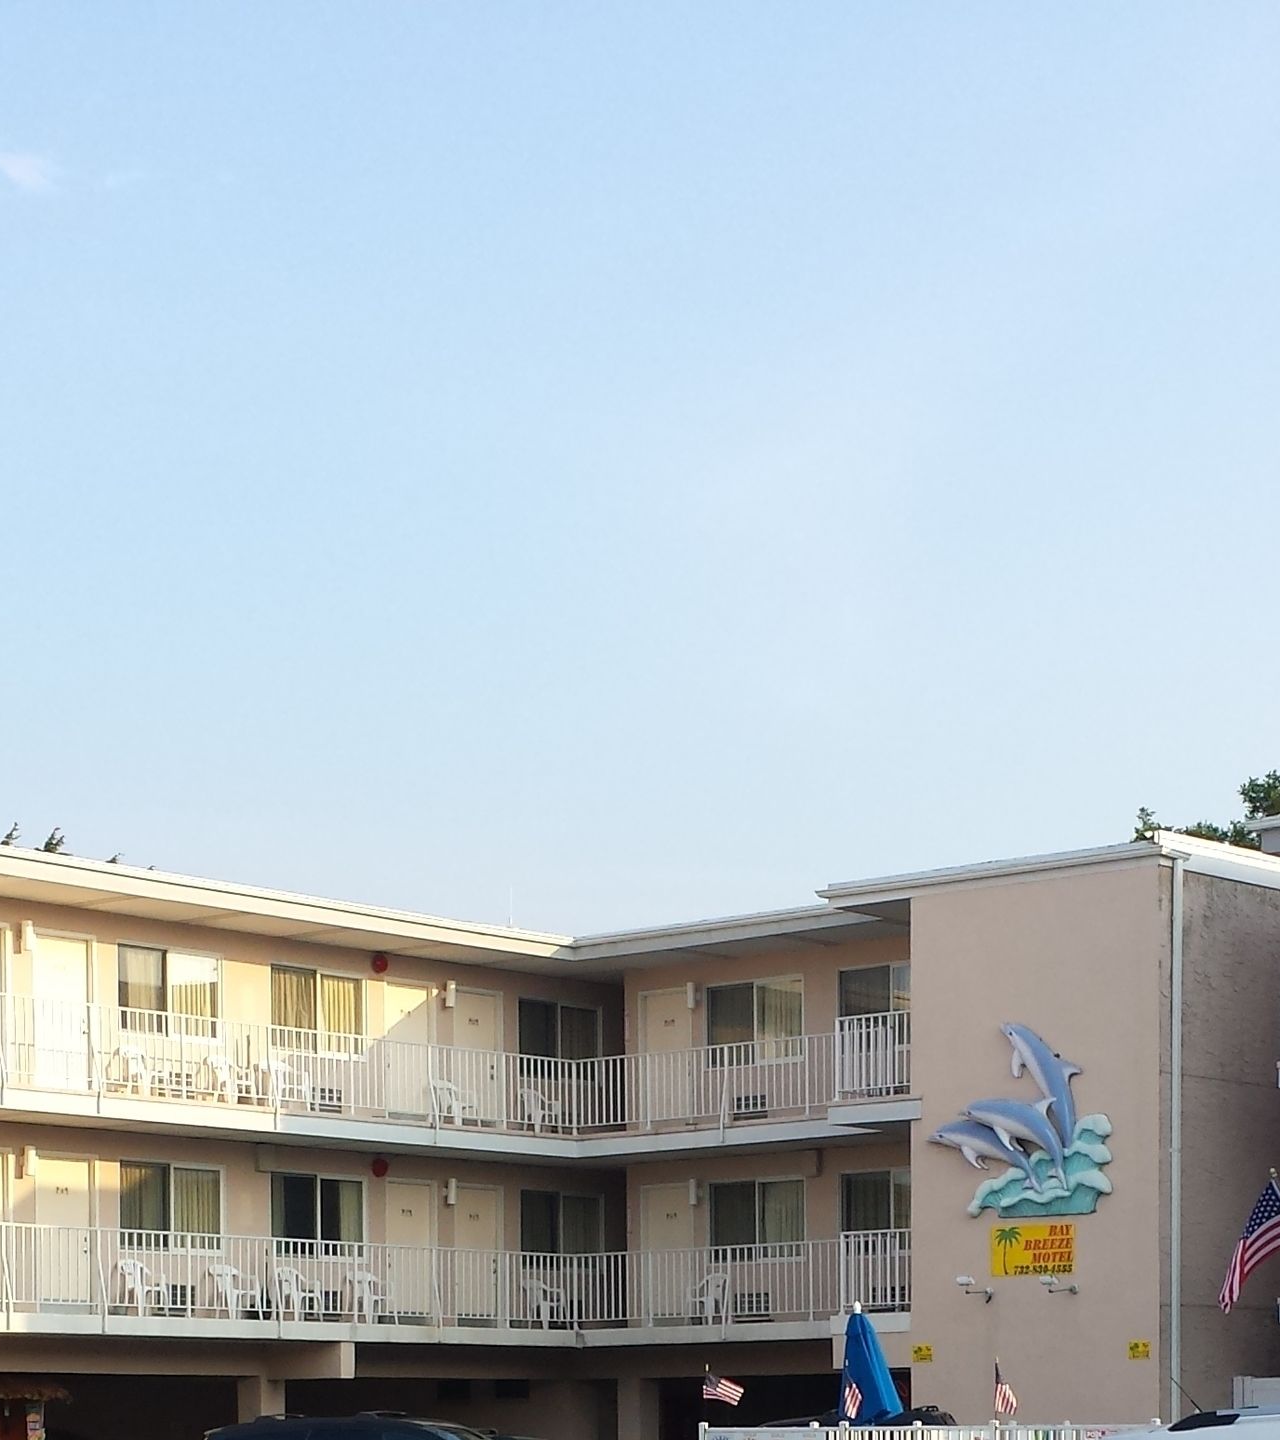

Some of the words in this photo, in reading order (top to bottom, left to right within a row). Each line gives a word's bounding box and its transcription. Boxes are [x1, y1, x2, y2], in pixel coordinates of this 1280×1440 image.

[1048, 1224, 1072, 1236] BAY
[1024, 1238, 1073, 1250] BREEZE
[1031, 1251, 1073, 1264] MOTEL
